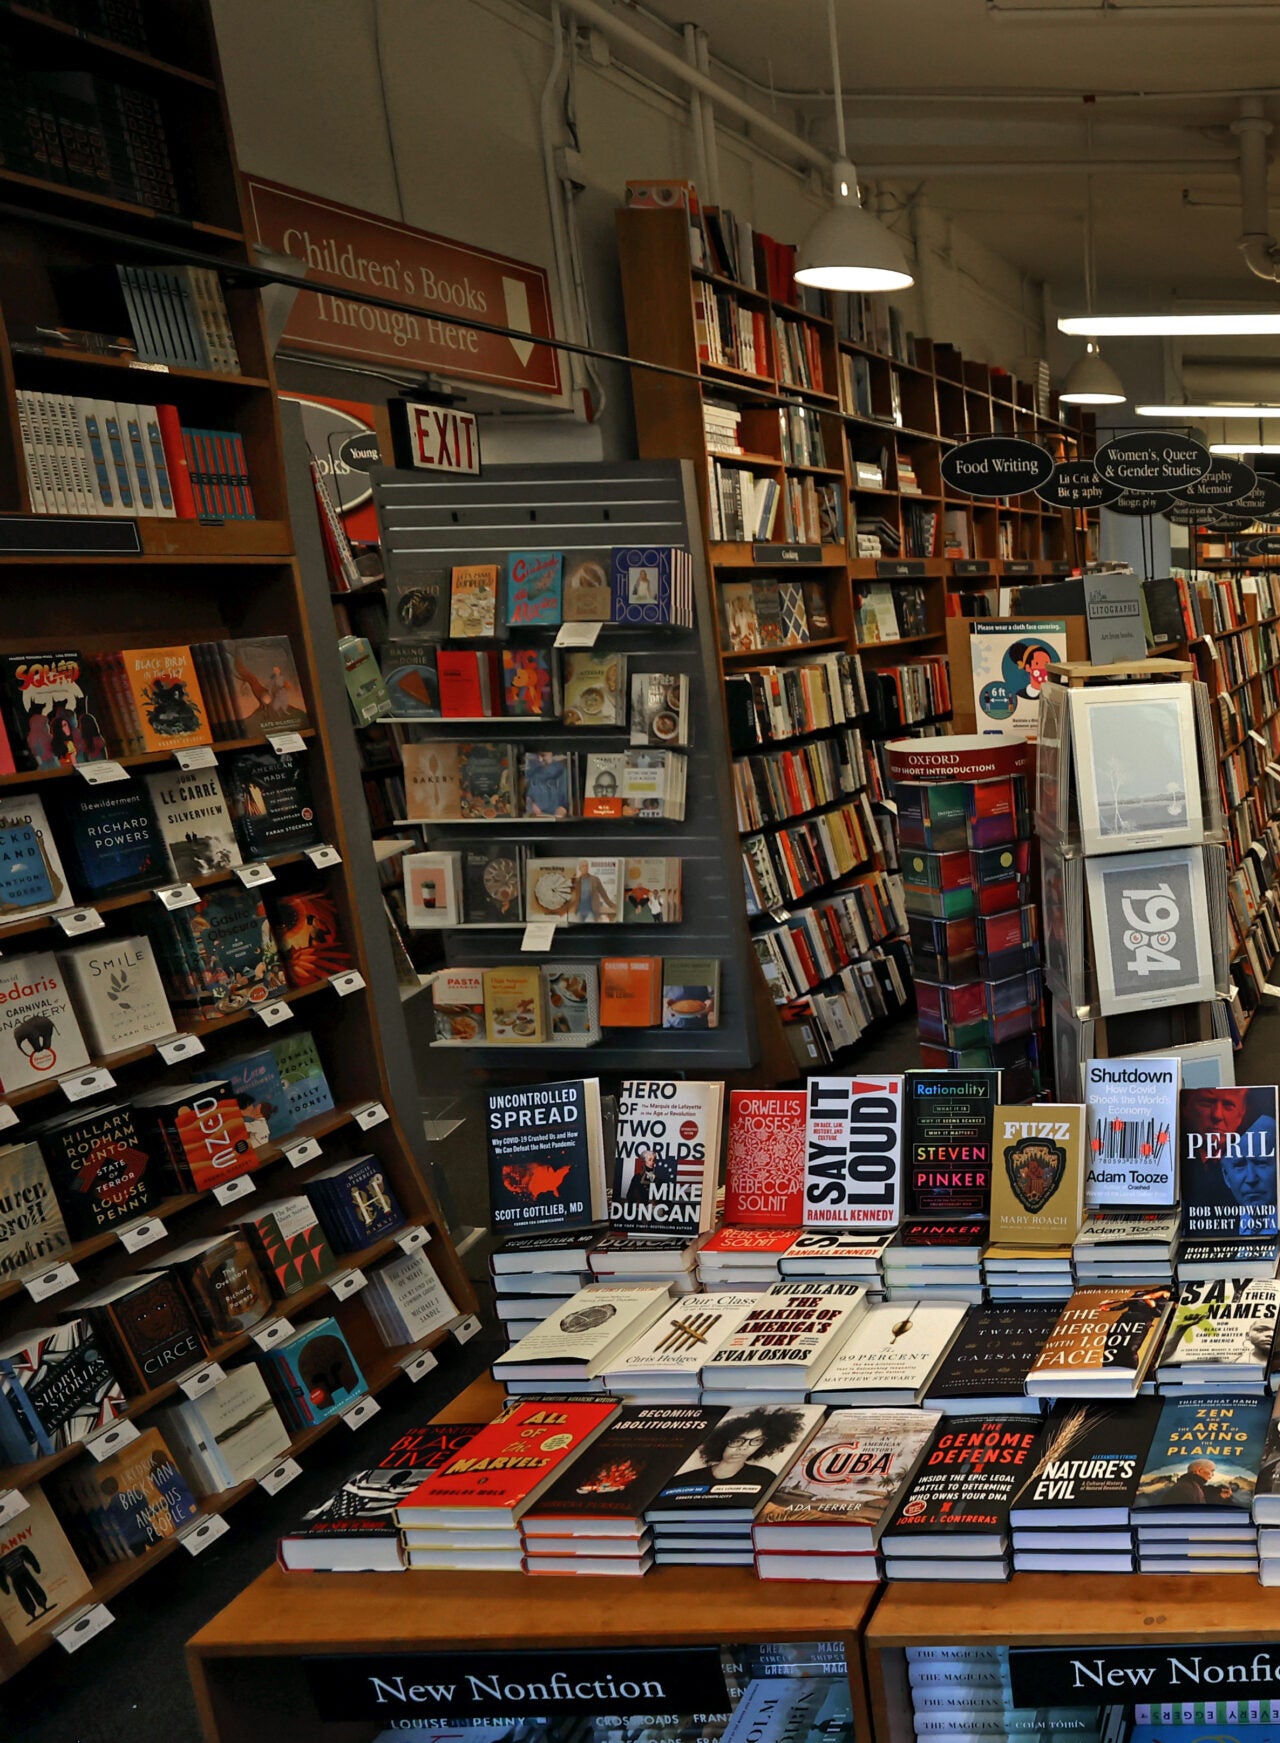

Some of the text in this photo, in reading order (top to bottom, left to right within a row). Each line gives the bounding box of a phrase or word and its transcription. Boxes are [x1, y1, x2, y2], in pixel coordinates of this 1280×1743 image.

[283, 229, 488, 312] Children's Books
[317, 292, 479, 352] Through Here
[415, 409, 473, 469] EXIT
[1108, 449, 1197, 462] Women's, Queer
[956, 459, 1038, 475] Food Writing
[1106, 464, 1201, 476] & Gender Studies
[1187, 484, 1232, 494] & Memoir
[1092, 605, 1137, 615] LITOGRAPHS
[992, 688, 1006, 696] 6 ft
[909, 755, 959, 764] OXFORD
[926, 764, 995, 774] INTRODUCTIONS
[161, 779, 218, 805] LE CARRÉ
[168, 806, 223, 824] SILVERVIEW
[88, 818, 148, 836] RICHARD
[95, 831, 149, 849] POWERS
[1121, 882, 1181, 976] 1984
[89, 951, 145, 977] SMILE
[1091, 1068, 1173, 1083] Shutdown
[489, 1088, 577, 1109] UNCONTROLLED
[620, 1081, 677, 1099] HERO
[917, 1084, 985, 1097] Rationality
[619, 1103, 638, 1115] OF
[738, 1100, 800, 1115] ORWELL'S
[490, 1106, 578, 1129] SPREAD
[745, 1117, 790, 1131] ROSES
[62, 1112, 130, 1146] HILLARY
[619, 1120, 666, 1138] TWO
[1003, 1121, 1070, 1140] FUZZ
[68, 1125, 135, 1158] RODHAM
[806, 1081, 849, 1205] SAY IT
[848, 1081, 898, 1205] LOUD!
[1186, 1131, 1275, 1159] PERIL
[71, 1136, 139, 1171] CLINTON
[616, 1143, 705, 1160] WORLDS
[917, 1147, 986, 1161] STEVEN
[917, 1174, 985, 1187] PINKER
[1087, 1170, 1168, 1183] Adam Tooze
[649, 1183, 702, 1201] MIKE
[611, 1203, 700, 1223] DUNCAN
[1000, 1215, 1067, 1225] MARY ROACH
[1189, 1205, 1275, 1217] BOB WOODWARD
[1180, 1278, 1253, 1306] SAY
[1244, 1292, 1276, 1301] THEIR
[1205, 1303, 1277, 1319] NAMES
[143, 1335, 198, 1375] CIRCE
[938, 1434, 1034, 1449] GENOME
[805, 1442, 894, 1485] CUBA
[927, 1451, 1026, 1466] DEFENSE
[1042, 1461, 1136, 1479] NATURE'S
[1033, 1481, 1075, 1500] EVIL
[786, 1503, 862, 1512] ADA FERRER
[1072, 1659, 1156, 1688] New
[369, 1673, 666, 1703] New Nonfiction
